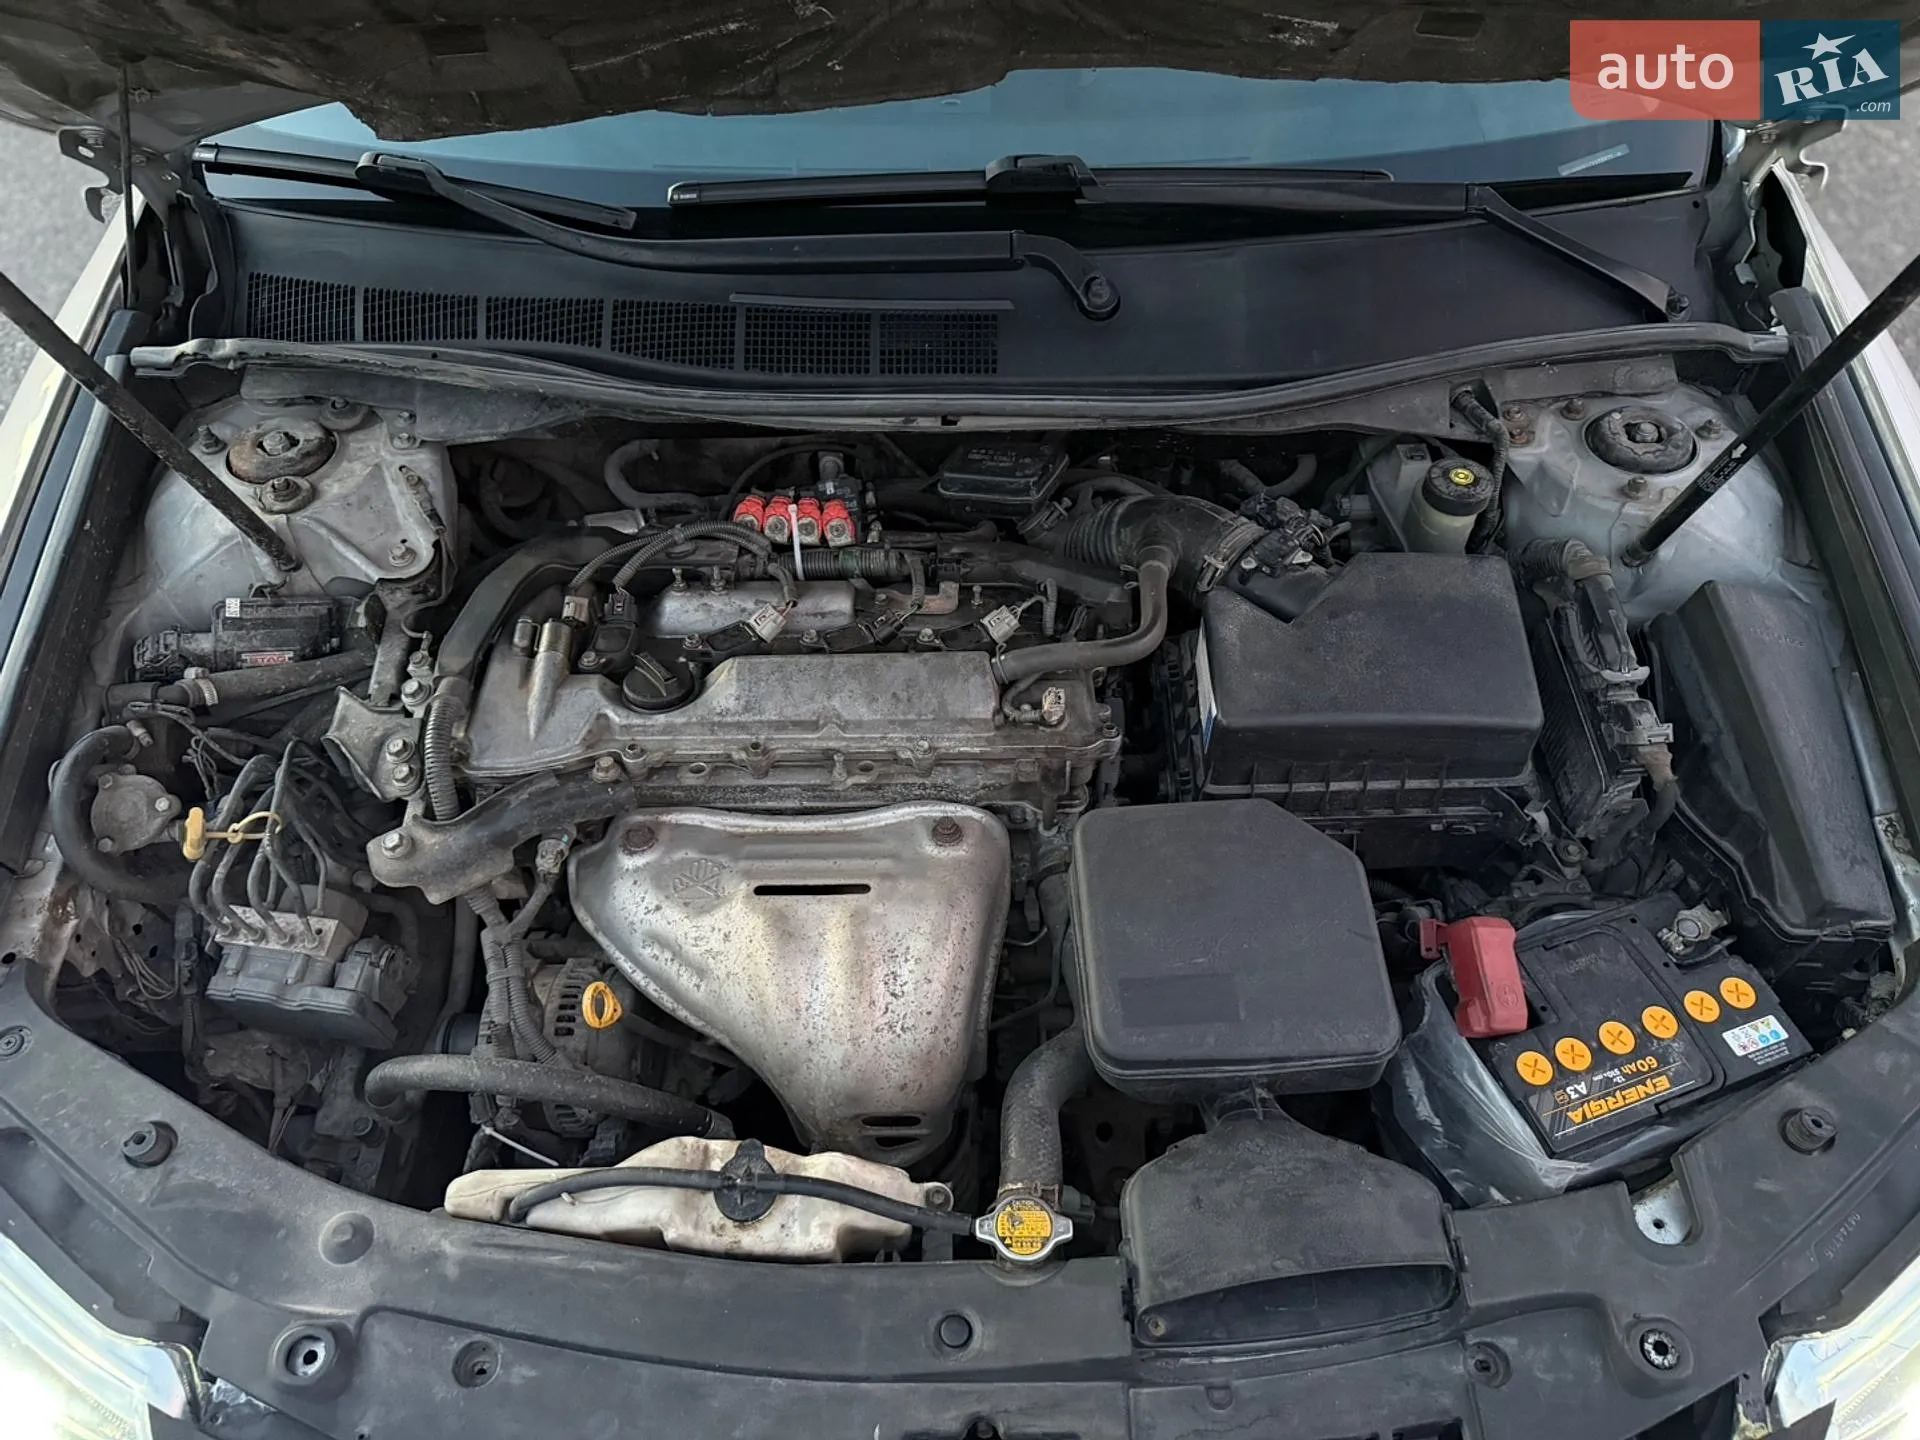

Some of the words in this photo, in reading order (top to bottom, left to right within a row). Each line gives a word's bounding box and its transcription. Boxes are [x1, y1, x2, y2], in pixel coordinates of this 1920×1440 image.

[1620, 1056, 1658, 1075] 60Ah
[1565, 1081, 1588, 1100] A3
[1566, 1075, 1671, 1125] ENERGIA
